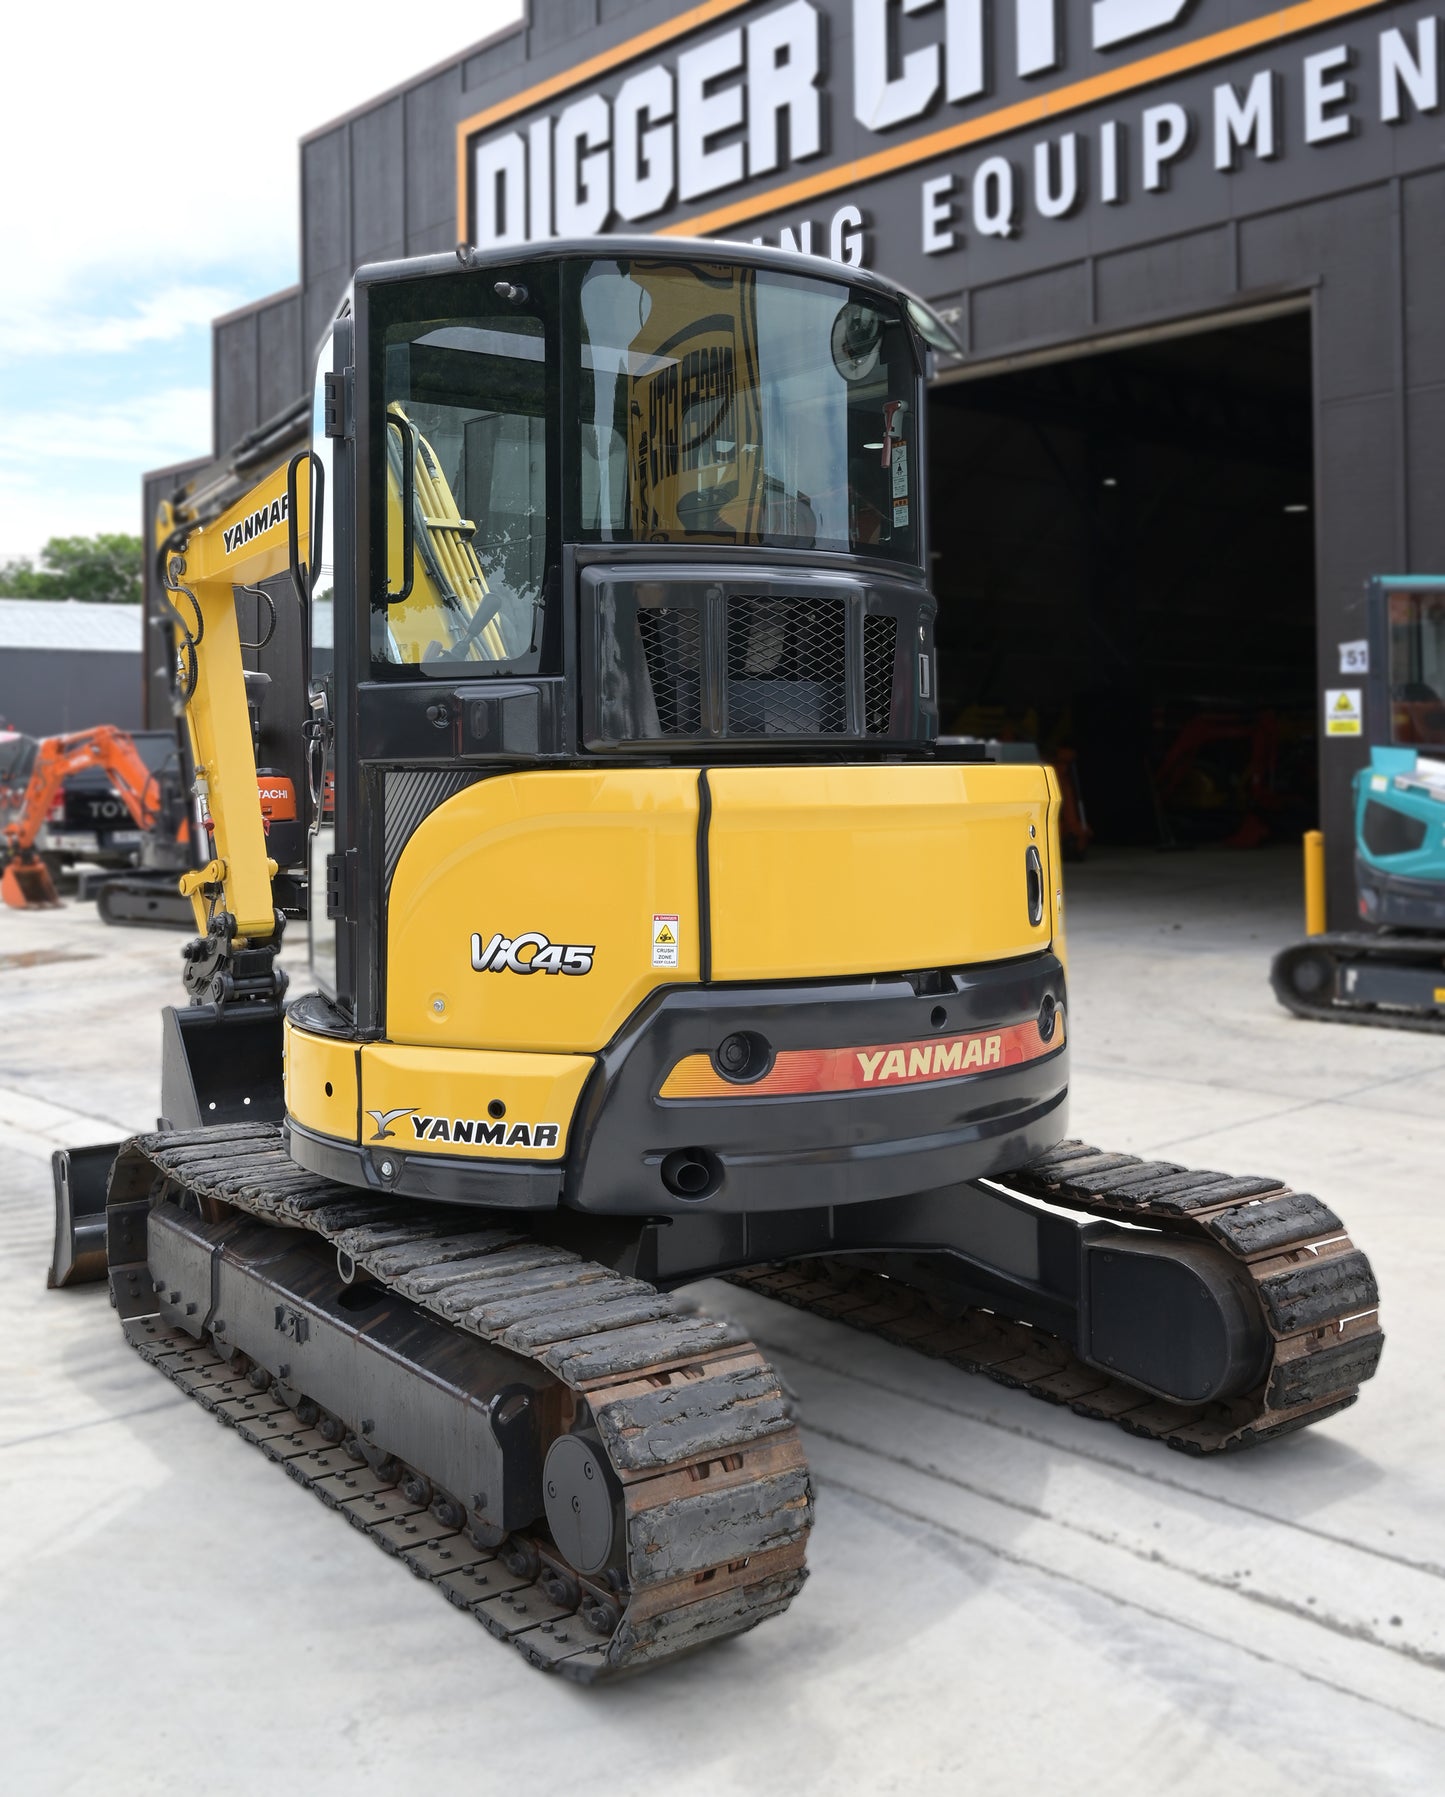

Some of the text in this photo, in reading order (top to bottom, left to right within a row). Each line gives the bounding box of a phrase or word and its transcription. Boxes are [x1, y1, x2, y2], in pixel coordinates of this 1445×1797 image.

[476, 2, 820, 249] DIGGER
[856, 1035, 1001, 1082] YANMAR
[411, 1115, 561, 1149] YANMAR
